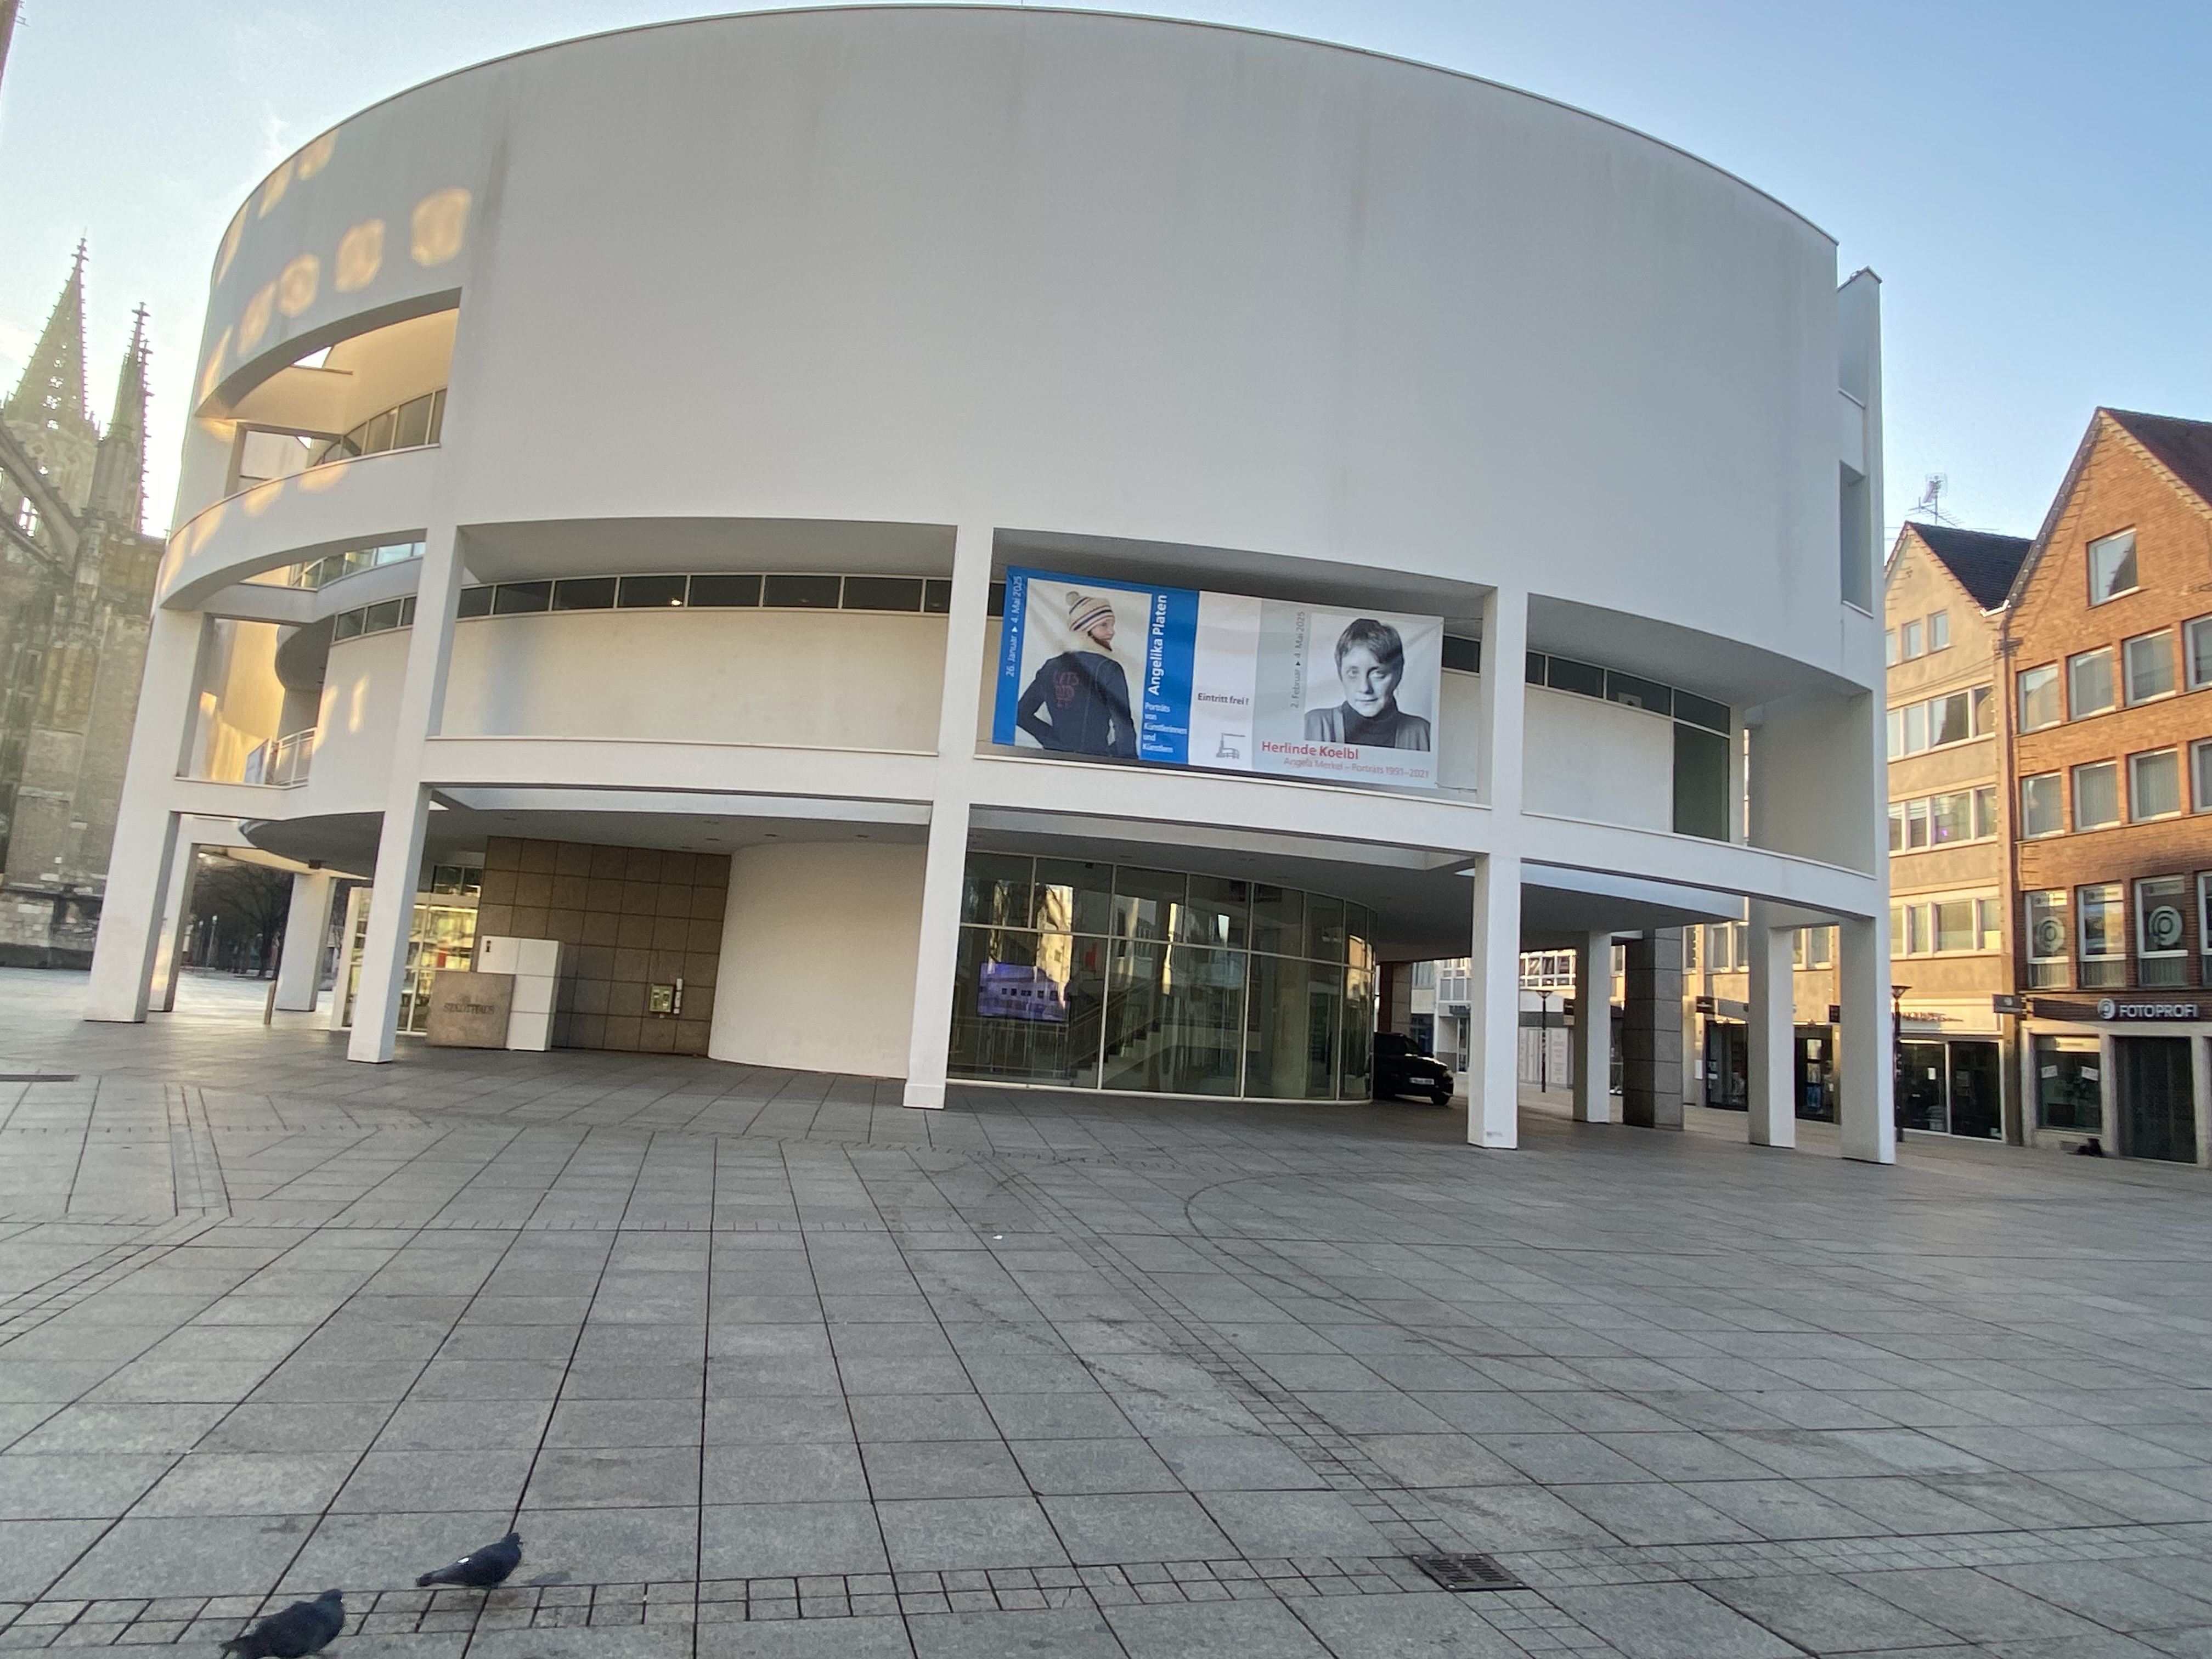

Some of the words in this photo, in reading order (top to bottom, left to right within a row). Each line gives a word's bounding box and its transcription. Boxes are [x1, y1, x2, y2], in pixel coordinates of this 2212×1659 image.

[1013, 576, 1023, 597] 2025
[1011, 597, 1021, 614] Mai
[1152, 595, 1167, 635] Platen
[1295, 611, 1305, 632] 2025
[1007, 635, 1017, 662] Januar
[1294, 633, 1304, 648] Mai
[1006, 662, 1015, 678] 26.
[1148, 639, 1164, 696] Angelika
[1291, 669, 1301, 699] Februar
[1197, 692, 1228, 703] Eintritt
[1261, 741, 1316, 755] Herlinde
[1319, 745, 1359, 760] Koelbl
[1283, 757, 1313, 768] Angela
[1314, 759, 1343, 770] Merkel
[2118, 1003, 2198, 1018] FOTOPROFI
